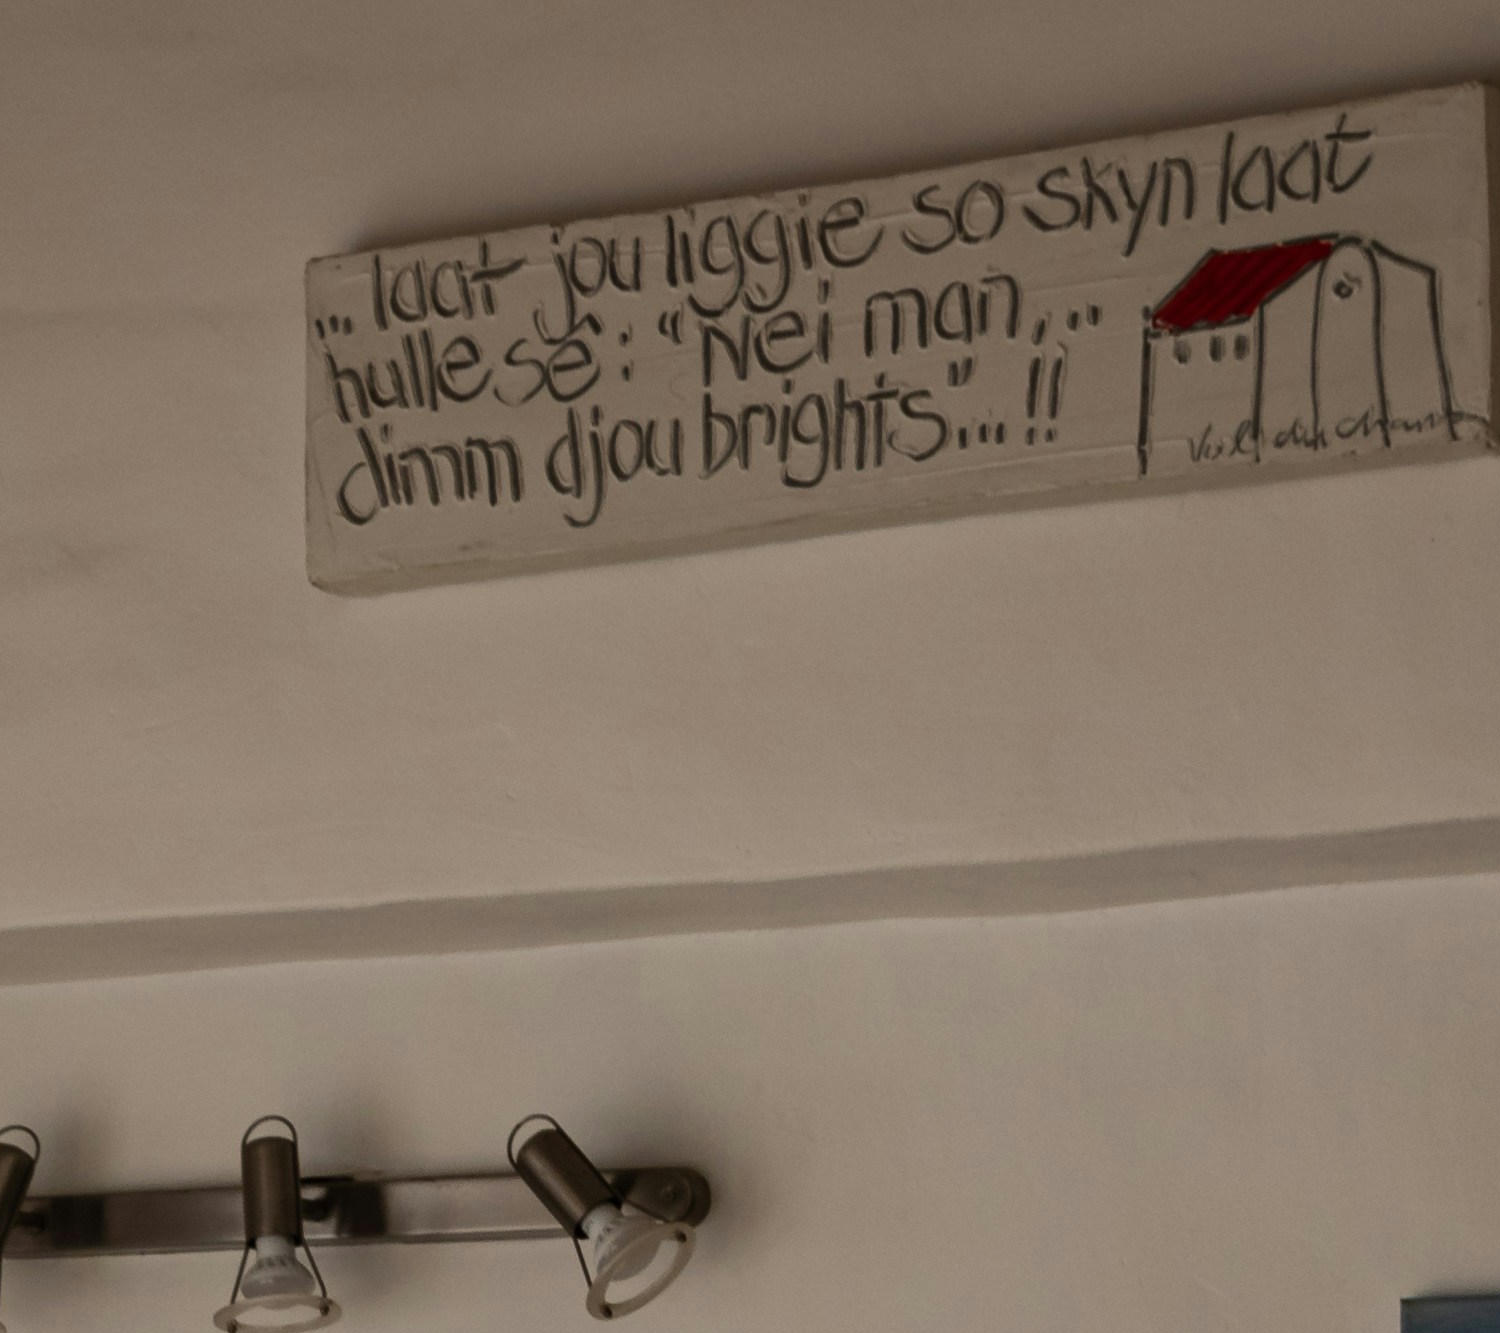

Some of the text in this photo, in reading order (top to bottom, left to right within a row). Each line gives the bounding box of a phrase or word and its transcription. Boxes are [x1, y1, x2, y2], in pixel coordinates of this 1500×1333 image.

[533, 230, 643, 345] jou
[666, 193, 886, 318] liggie
[902, 180, 1005, 255] so
[1023, 156, 1195, 258] skyn
[1216, 112, 1374, 227] laat
[323, 327, 494, 424] hulle
[545, 403, 684, 528] djou
